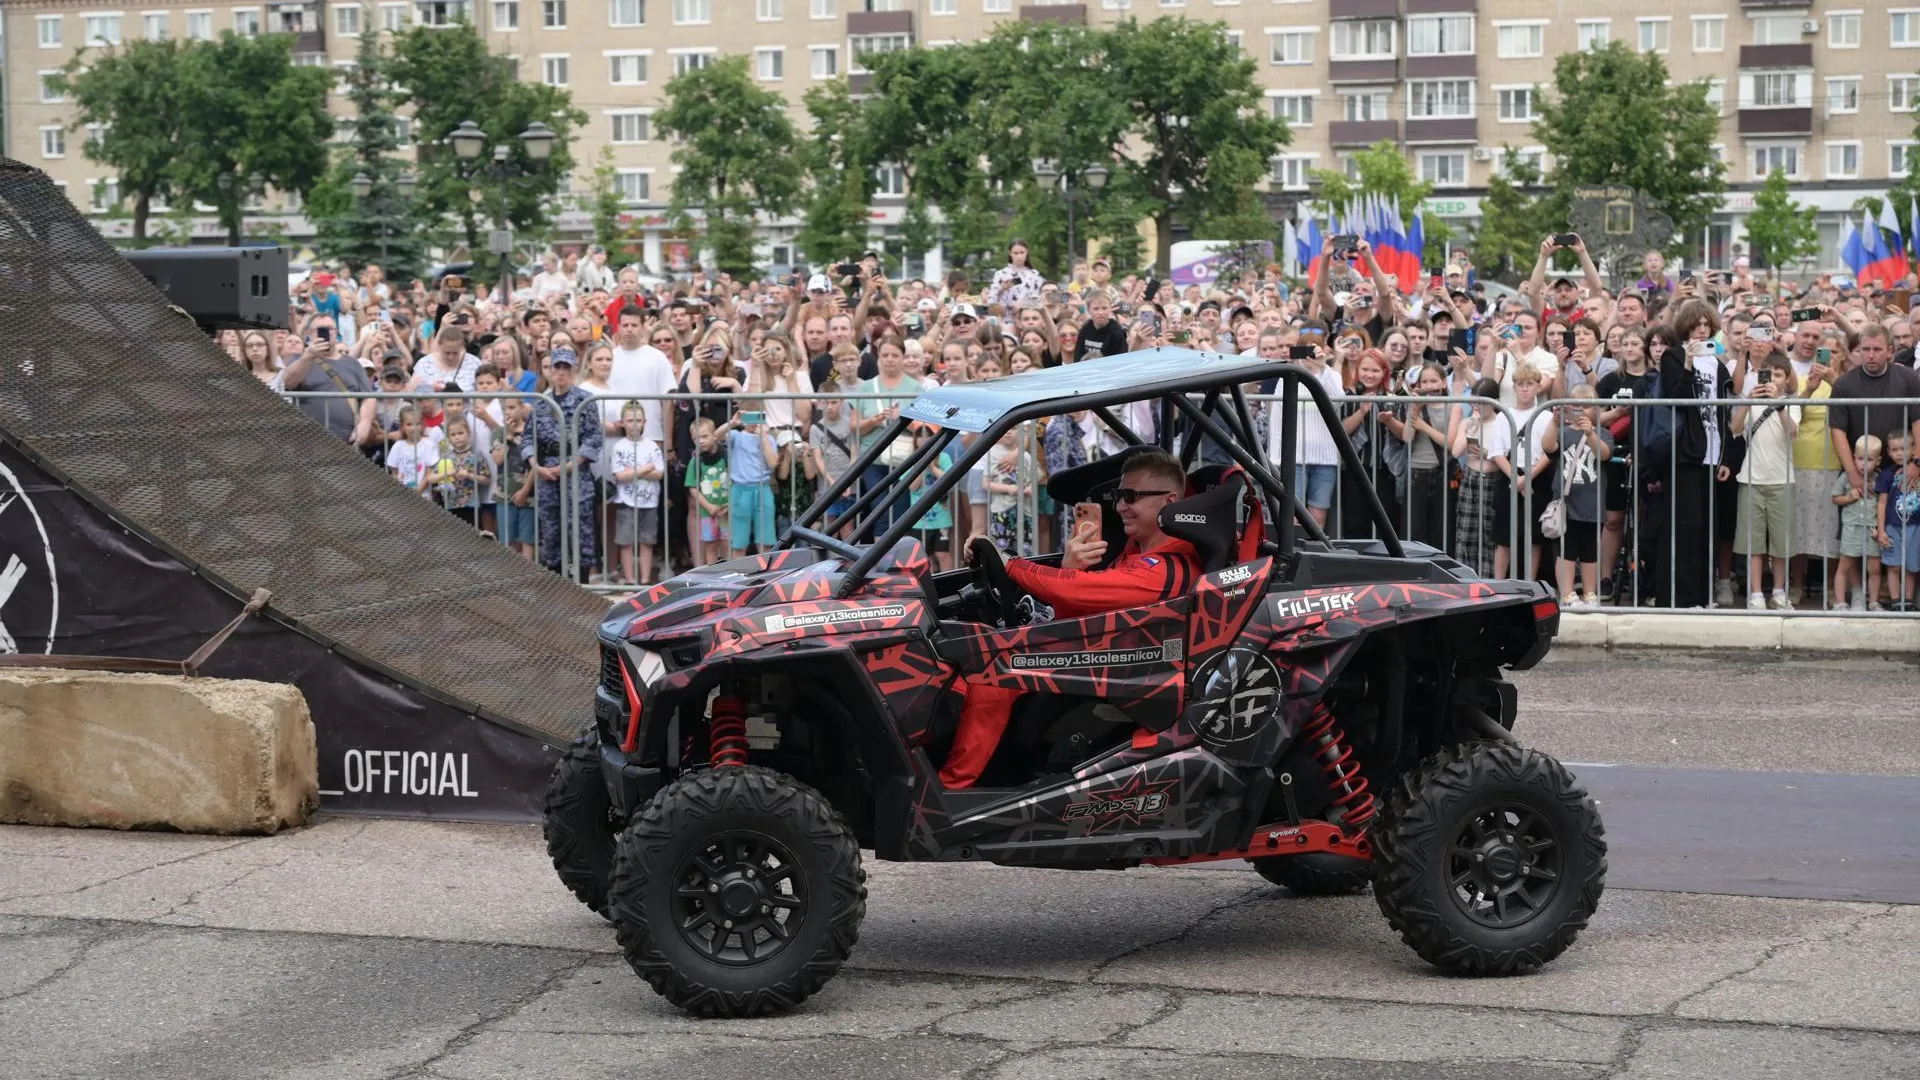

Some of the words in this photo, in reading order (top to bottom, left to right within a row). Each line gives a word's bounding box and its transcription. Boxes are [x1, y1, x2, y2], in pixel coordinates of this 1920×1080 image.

[1218, 565, 1249, 580] BULLET
[784, 608, 903, 627] @alexey13kolesnikov
[1013, 650, 1161, 667] @alexey13kolesnikov
